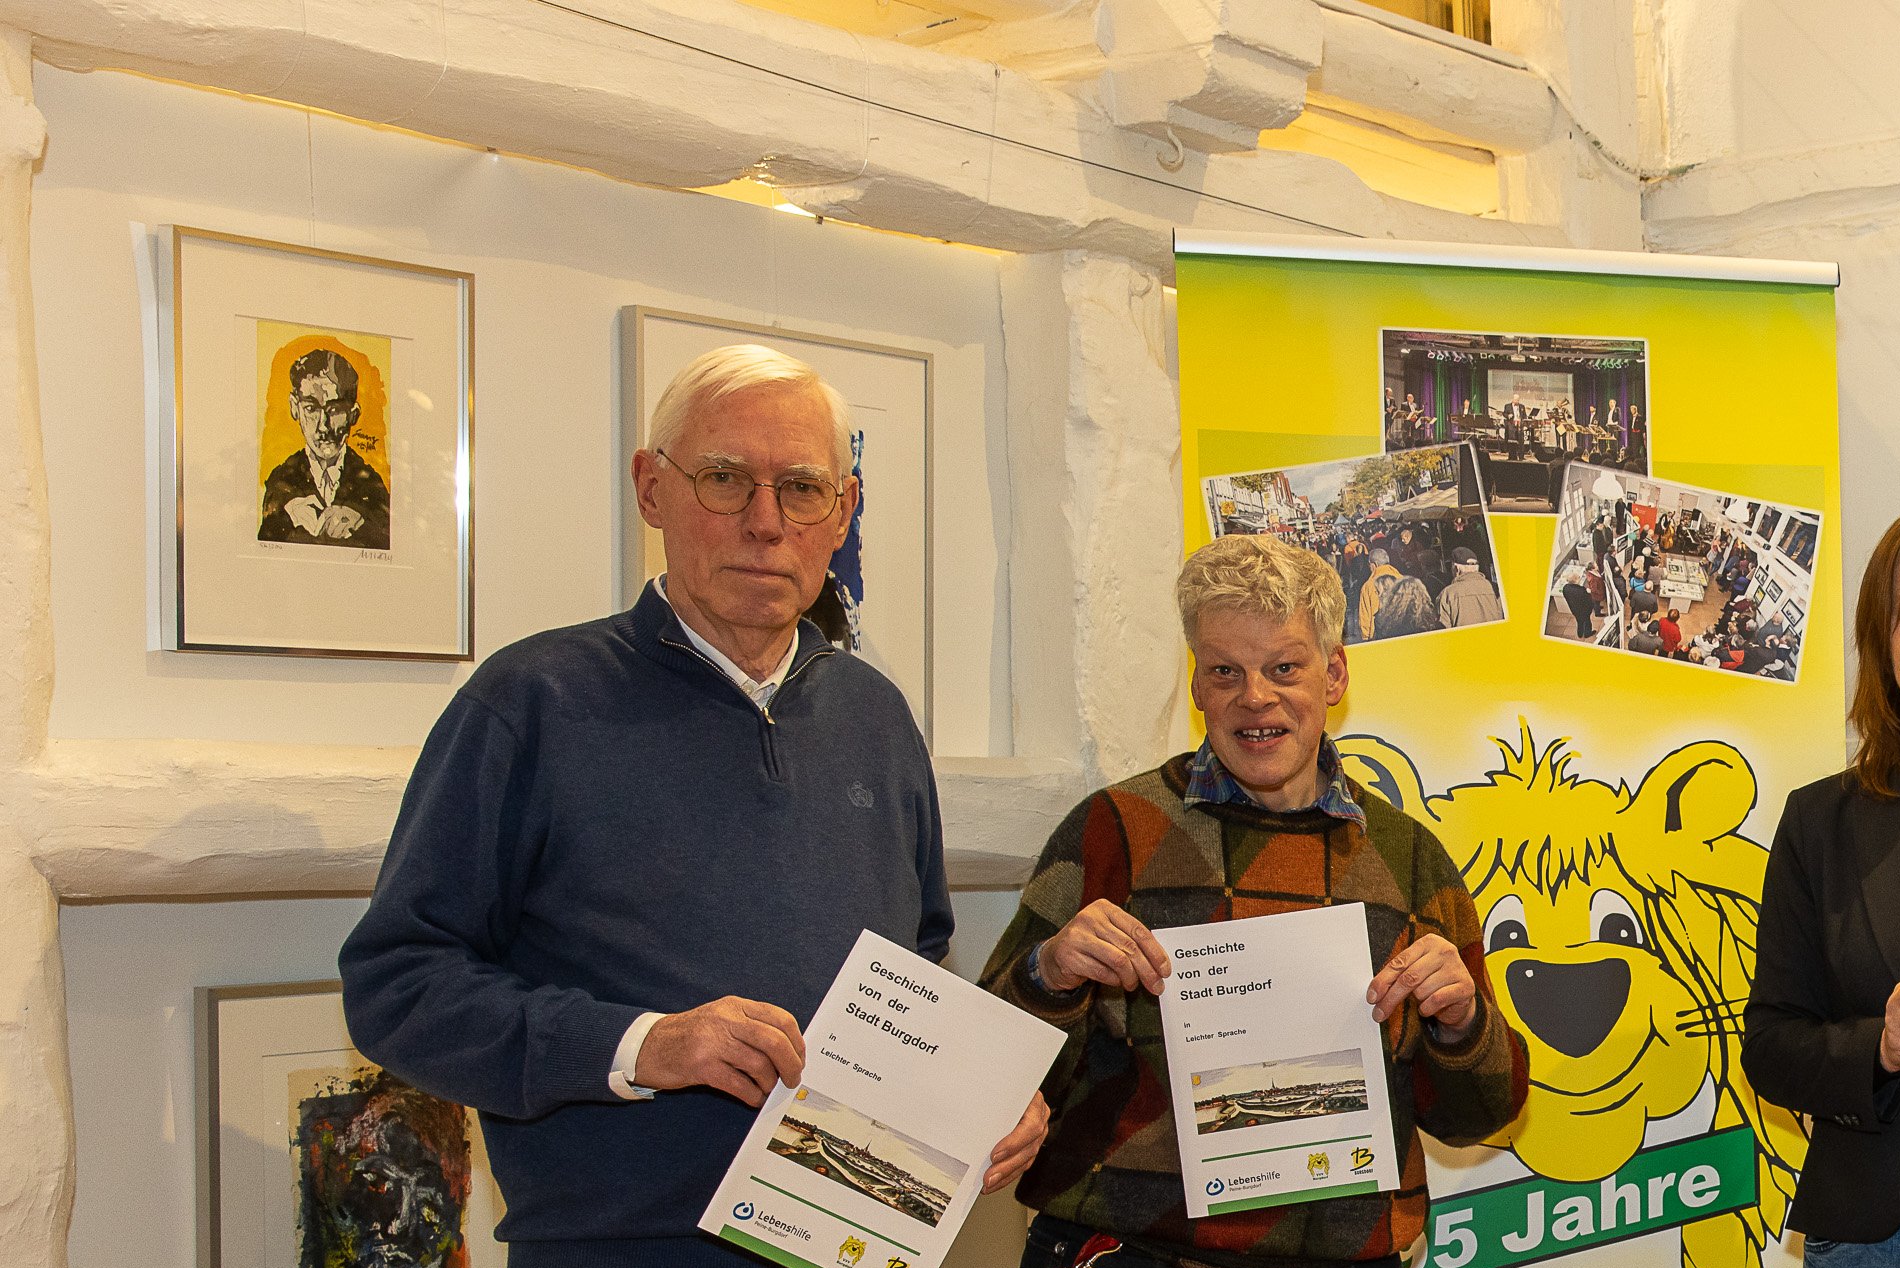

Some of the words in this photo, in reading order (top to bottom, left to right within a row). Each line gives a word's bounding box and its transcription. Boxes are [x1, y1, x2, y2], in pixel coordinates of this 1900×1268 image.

[1174, 941, 1246, 960] Geschichte
[869, 960, 940, 1004] Geschichte
[1177, 968, 1201, 980] von
[1207, 964, 1229, 977] der
[857, 982, 882, 1002] von
[887, 994, 910, 1016] der
[1180, 986, 1214, 1001] Stadt
[1216, 978, 1273, 1000] Burgdorf
[828, 1032, 837, 1042] in
[845, 1002, 881, 1029] Stadt
[881, 1018, 939, 1057] Burgdorf
[1185, 1031, 1215, 1043] Leichter
[1217, 1027, 1247, 1039] Sprache
[820, 1047, 851, 1068] Leichter
[852, 1061, 883, 1083] Sprache
[1228, 1170, 1281, 1187] Lebenshilfe
[1501, 1163, 1721, 1253] Jahre
[757, 1211, 812, 1242] Lebenshilfe
